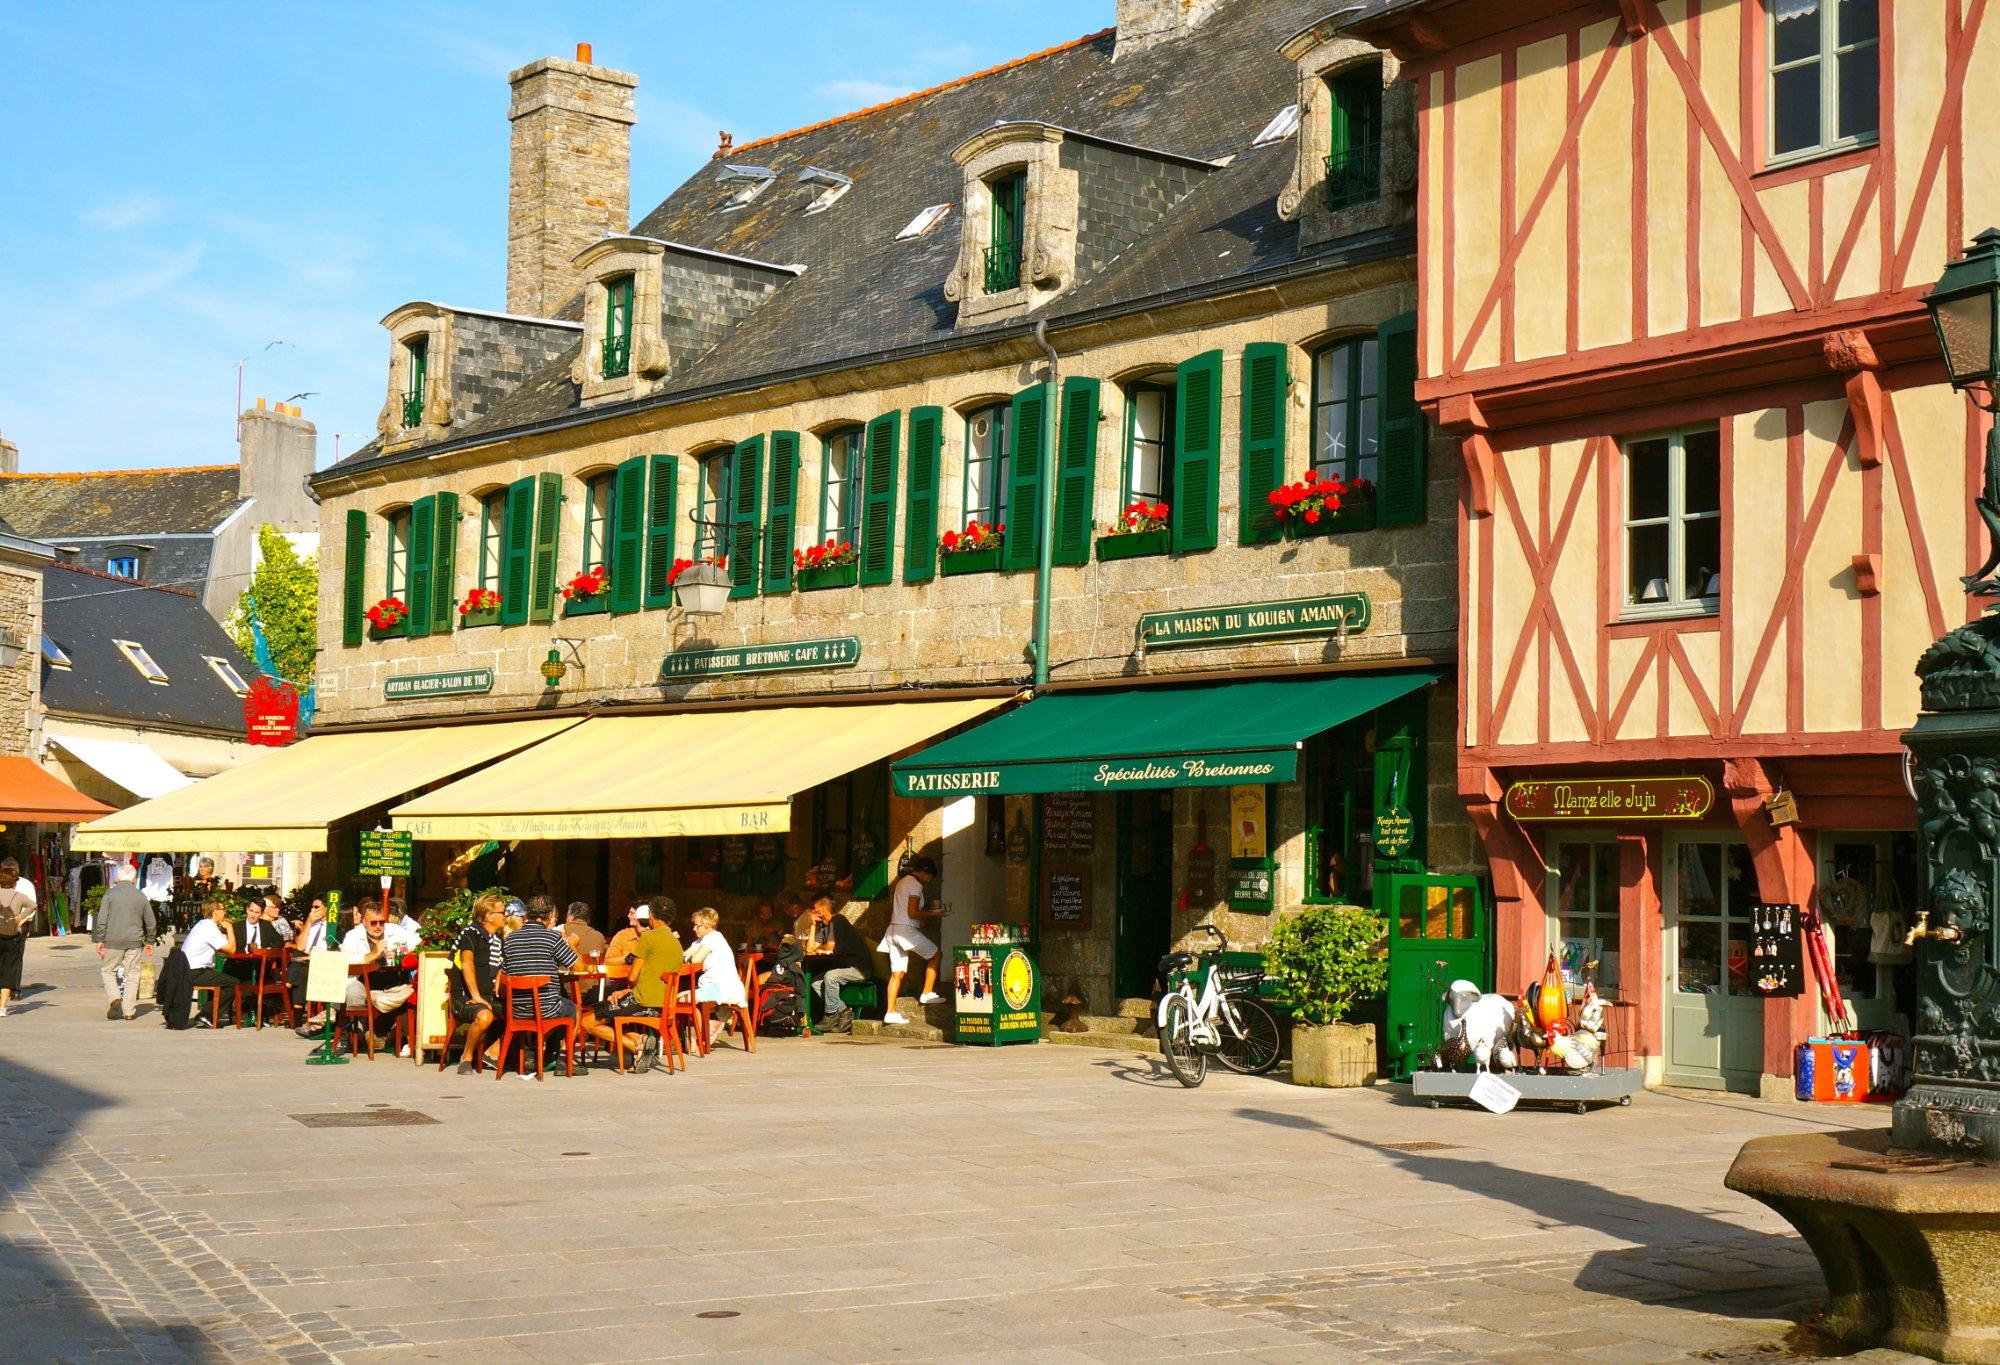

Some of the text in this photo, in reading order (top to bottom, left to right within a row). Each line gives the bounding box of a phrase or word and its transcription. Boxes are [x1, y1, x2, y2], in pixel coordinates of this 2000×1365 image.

[1155, 604, 1344, 636] LA MAISON DU KOUIGN AMANN
[694, 646, 818, 670] PATISSERIE BRETONNE CAFÉ
[387, 681, 412, 692] ARTISAN
[463, 675, 473, 686] DE
[908, 771, 1000, 791] PATISSERIE
[1093, 760, 1275, 787] Spécialités Bretonnes
[1554, 784, 1656, 815] Mamz'elle Juju
[502, 820, 516, 833] La
[519, 818, 554, 833] Maison
[556, 819, 568, 832] du
[740, 811, 768, 827] BAR
[370, 831, 403, 840] Bar Café
[369, 849, 404, 857] Milk Shake
[367, 858, 404, 867] Cappuccino
[328, 892, 339, 923] BAR
[960, 1017, 990, 1025] LA MAISON DU
[1000, 1012, 1036, 1022] LA MAISON DU
[1000, 1020, 1038, 1030] KOUIGN AMANN
